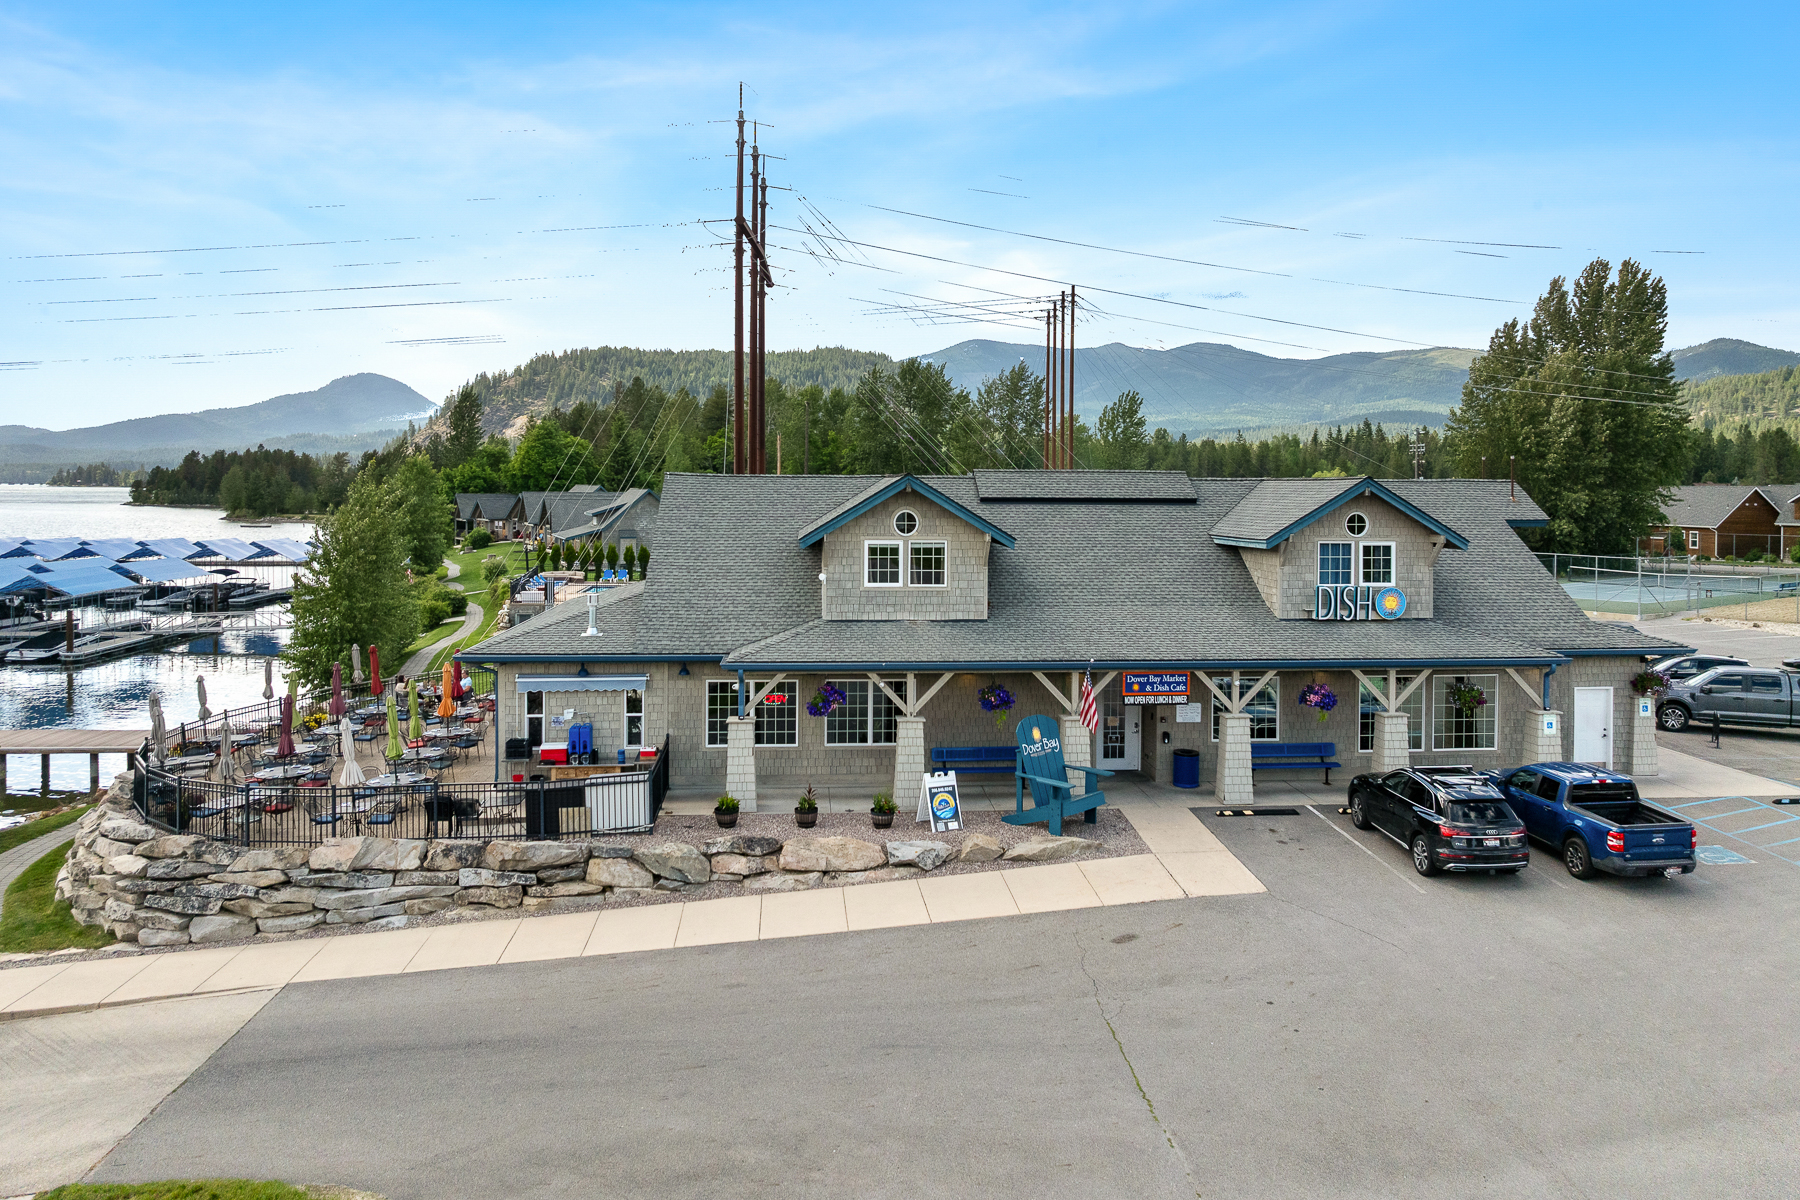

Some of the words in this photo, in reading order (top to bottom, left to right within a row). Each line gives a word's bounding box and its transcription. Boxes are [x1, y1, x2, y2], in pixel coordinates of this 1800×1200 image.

[1316, 585, 1373, 621] DISH
[1127, 675, 1148, 683] Dover
[1149, 675, 1161, 684] Bay
[1162, 674, 1186, 682] Market
[1145, 684, 1152, 692] &
[765, 694, 787, 704] OPEN
[1124, 696, 1134, 704] NOW
[1134, 696, 1146, 704] OPEN
[1145, 695, 1155, 704] FOR
[1154, 695, 1169, 704] LUNCH
[1172, 695, 1188, 704] DINNER
[1022, 742, 1043, 756] Dover
[1042, 737, 1060, 753] Bay
